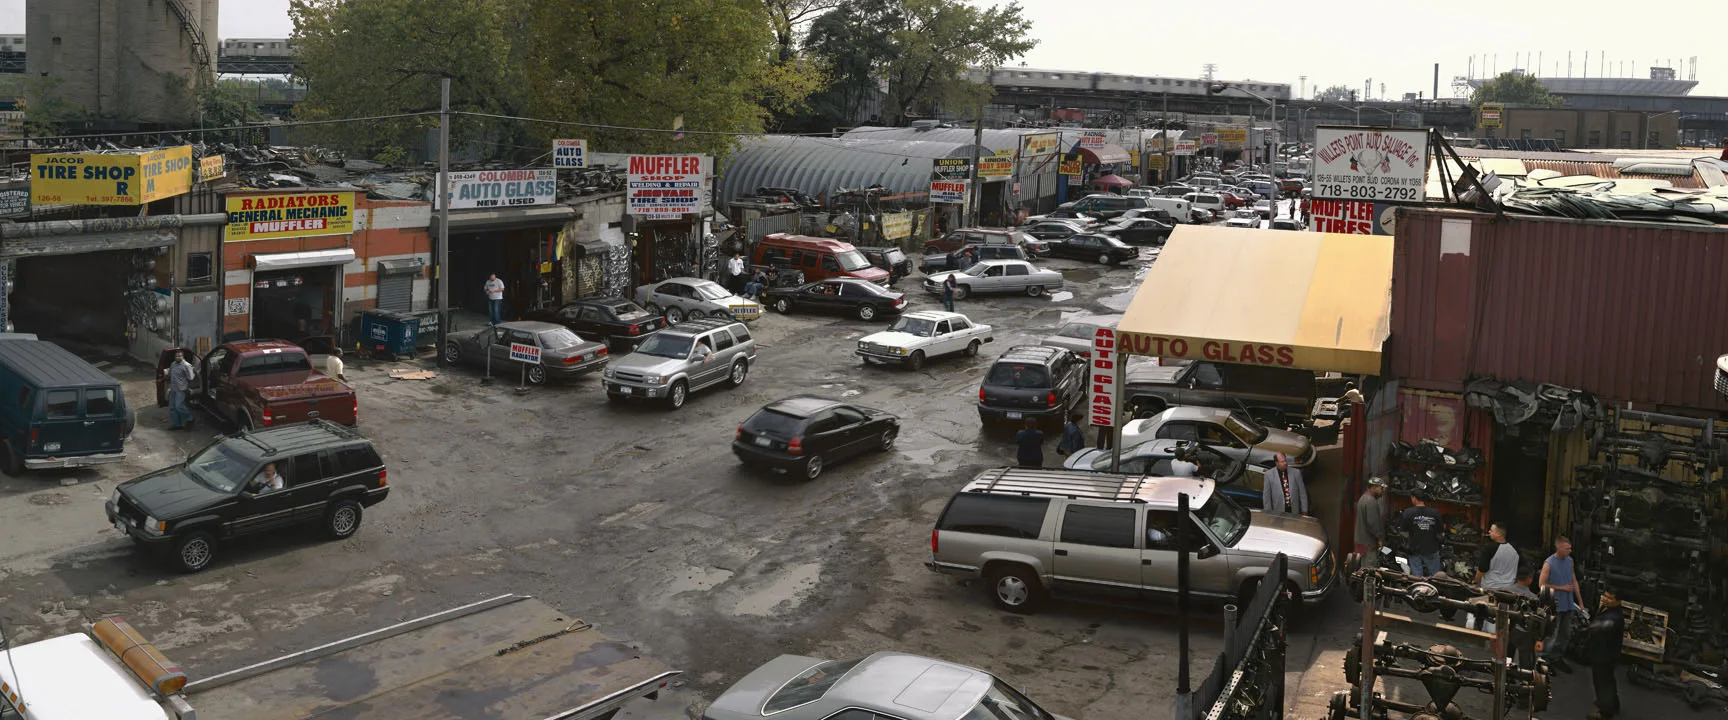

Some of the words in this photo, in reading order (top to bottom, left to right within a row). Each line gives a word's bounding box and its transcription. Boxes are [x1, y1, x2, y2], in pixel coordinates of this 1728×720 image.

[556, 147, 582, 156] AUTO
[1317, 137, 1346, 165] WILLETS
[1345, 133, 1364, 151] POINT
[1365, 132, 1382, 150] AUTO
[1384, 135, 1412, 161] SALVAGE
[143, 161, 162, 178] TIRE
[165, 156, 190, 173] SHOP
[555, 157, 583, 166] GLASS
[629, 156, 700, 174] MUFFLER
[934, 165, 955, 173] MUFFLER
[956, 164, 969, 172] SHOP
[37, 165, 77, 179] TIRE
[83, 165, 135, 180] SHOP
[479, 170, 536, 182] COLOMBIA
[1333, 175, 1352, 183] WILLETS
[1367, 176, 1378, 184] BLVD
[1380, 177, 1400, 185] CORONA
[116, 182, 129, 195] R
[146, 178, 155, 192] M
[458, 183, 502, 200] AUTO
[505, 180, 555, 198] GLASS
[931, 182, 965, 192] MUFFLER
[1320, 184, 1417, 200] 718-803-2792
[241, 195, 339, 210] RADIATORS
[476, 199, 499, 207] NEW
[508, 197, 536, 205] USED
[229, 209, 283, 223] GENERAL
[285, 205, 348, 219] MECHANIC
[1311, 200, 1373, 220] MUFFLER
[253, 219, 323, 233] MUFFLER
[1314, 216, 1371, 235] TIRES
[512, 343, 540, 356] MUFFLER
[1094, 328, 1114, 369] AUTO
[1117, 333, 1188, 357] AUTO
[1202, 341, 1294, 366] GLASS
[511, 351, 539, 362] RADIATOR
[1092, 374, 1113, 425] GLASS
